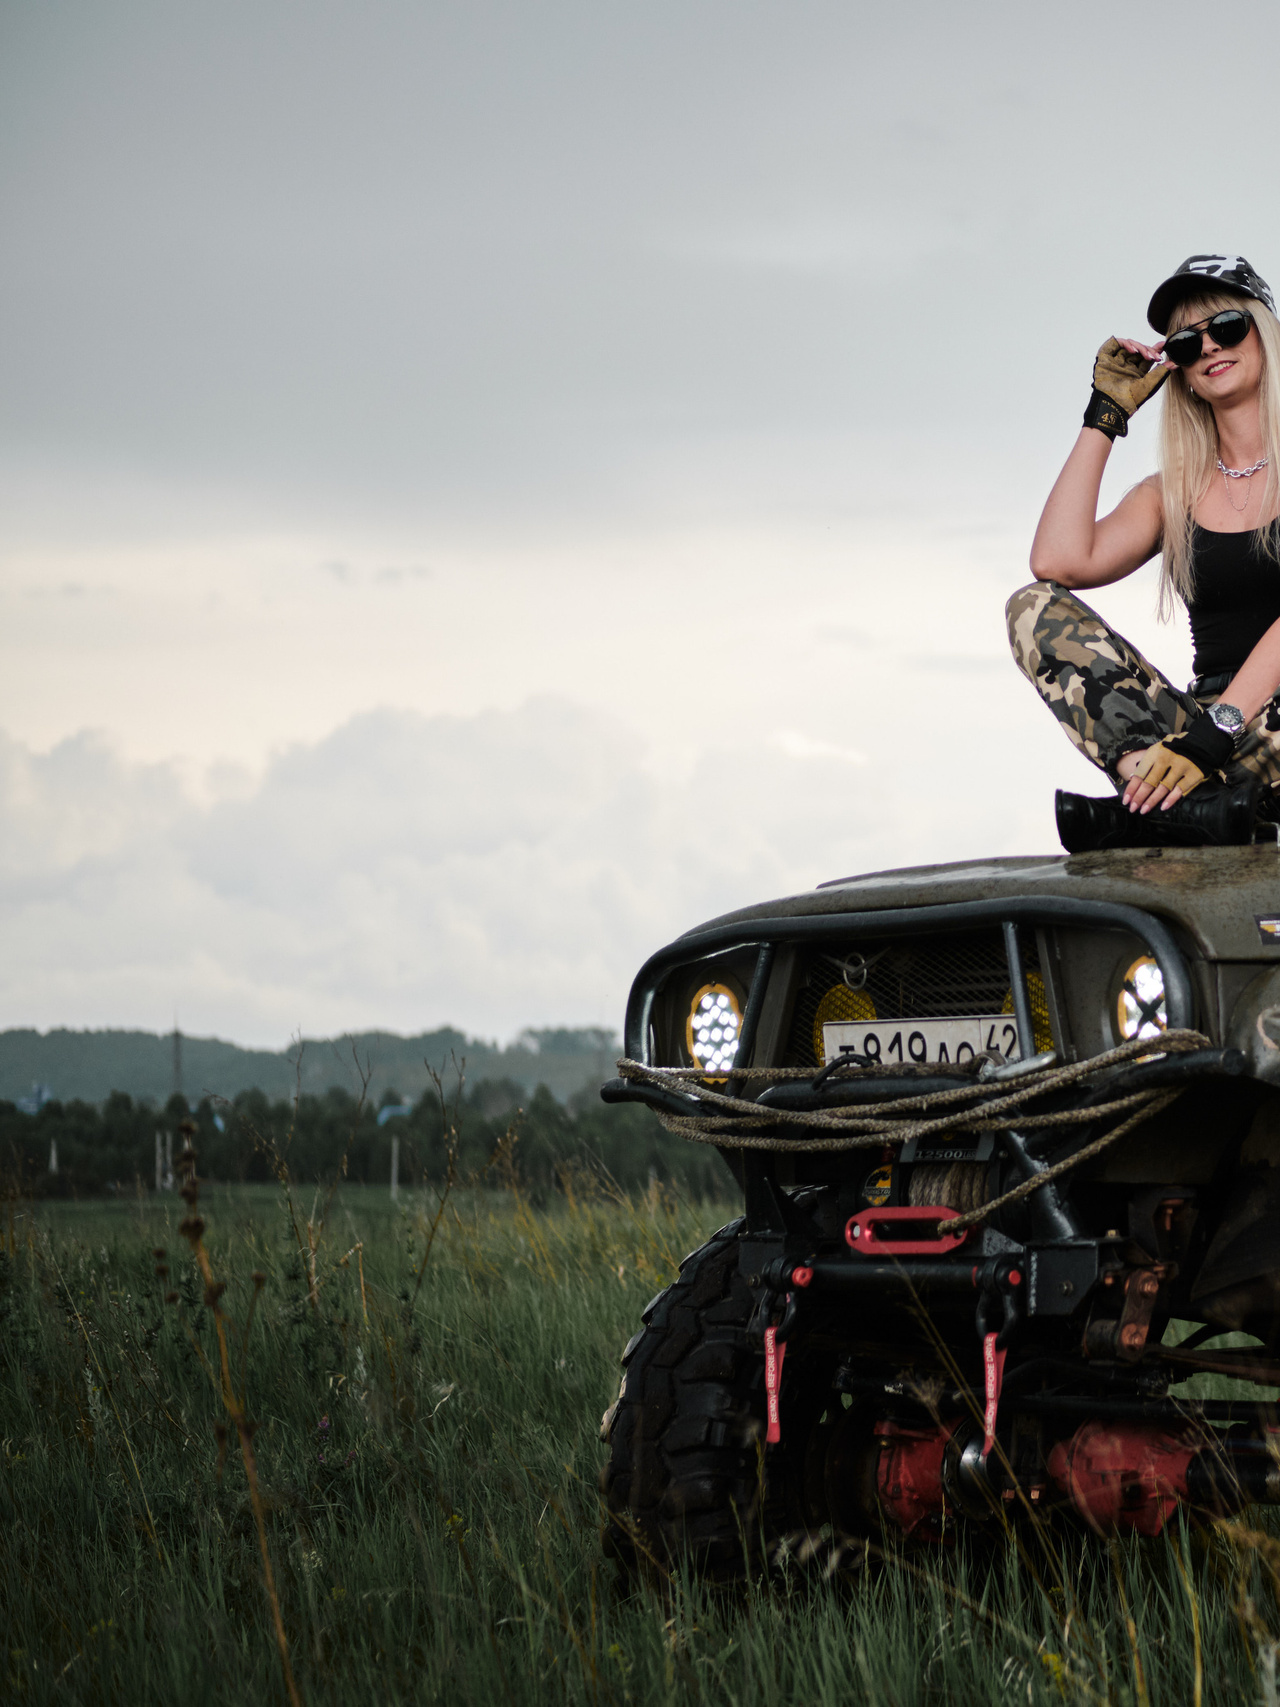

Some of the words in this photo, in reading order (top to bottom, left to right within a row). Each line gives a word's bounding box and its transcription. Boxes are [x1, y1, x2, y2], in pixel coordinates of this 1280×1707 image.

[766, 1329, 775, 1354] DRIVE
[767, 1354, 775, 1388] BEFORE
[986, 1363, 995, 1399] BEFORE
